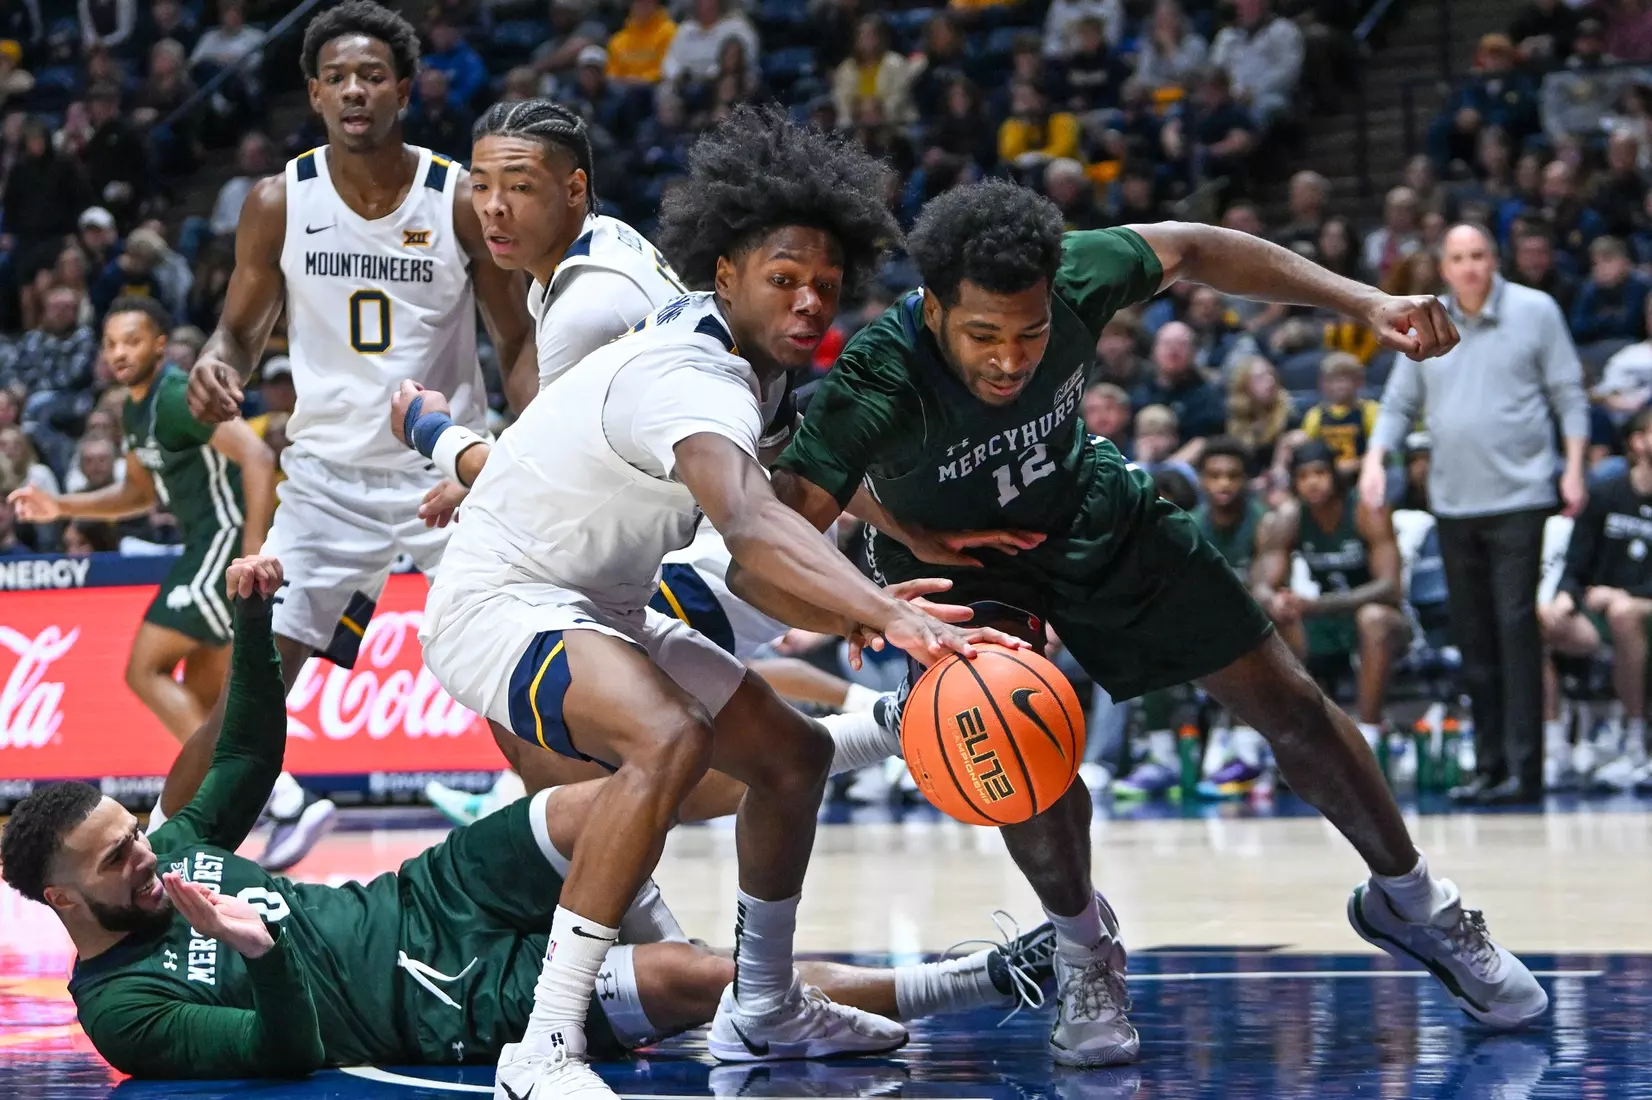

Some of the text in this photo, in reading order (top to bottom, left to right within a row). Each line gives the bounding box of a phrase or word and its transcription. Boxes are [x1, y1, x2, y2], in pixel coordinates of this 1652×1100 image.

[305, 251, 434, 283] MOUNTAINEERS
[348, 289, 392, 355] 0
[938, 377, 1085, 483] MERCYHURST
[992, 443, 1057, 508] 12
[947, 717, 992, 805] CAMPIONSHIP
[955, 705, 1016, 803] ELITE
